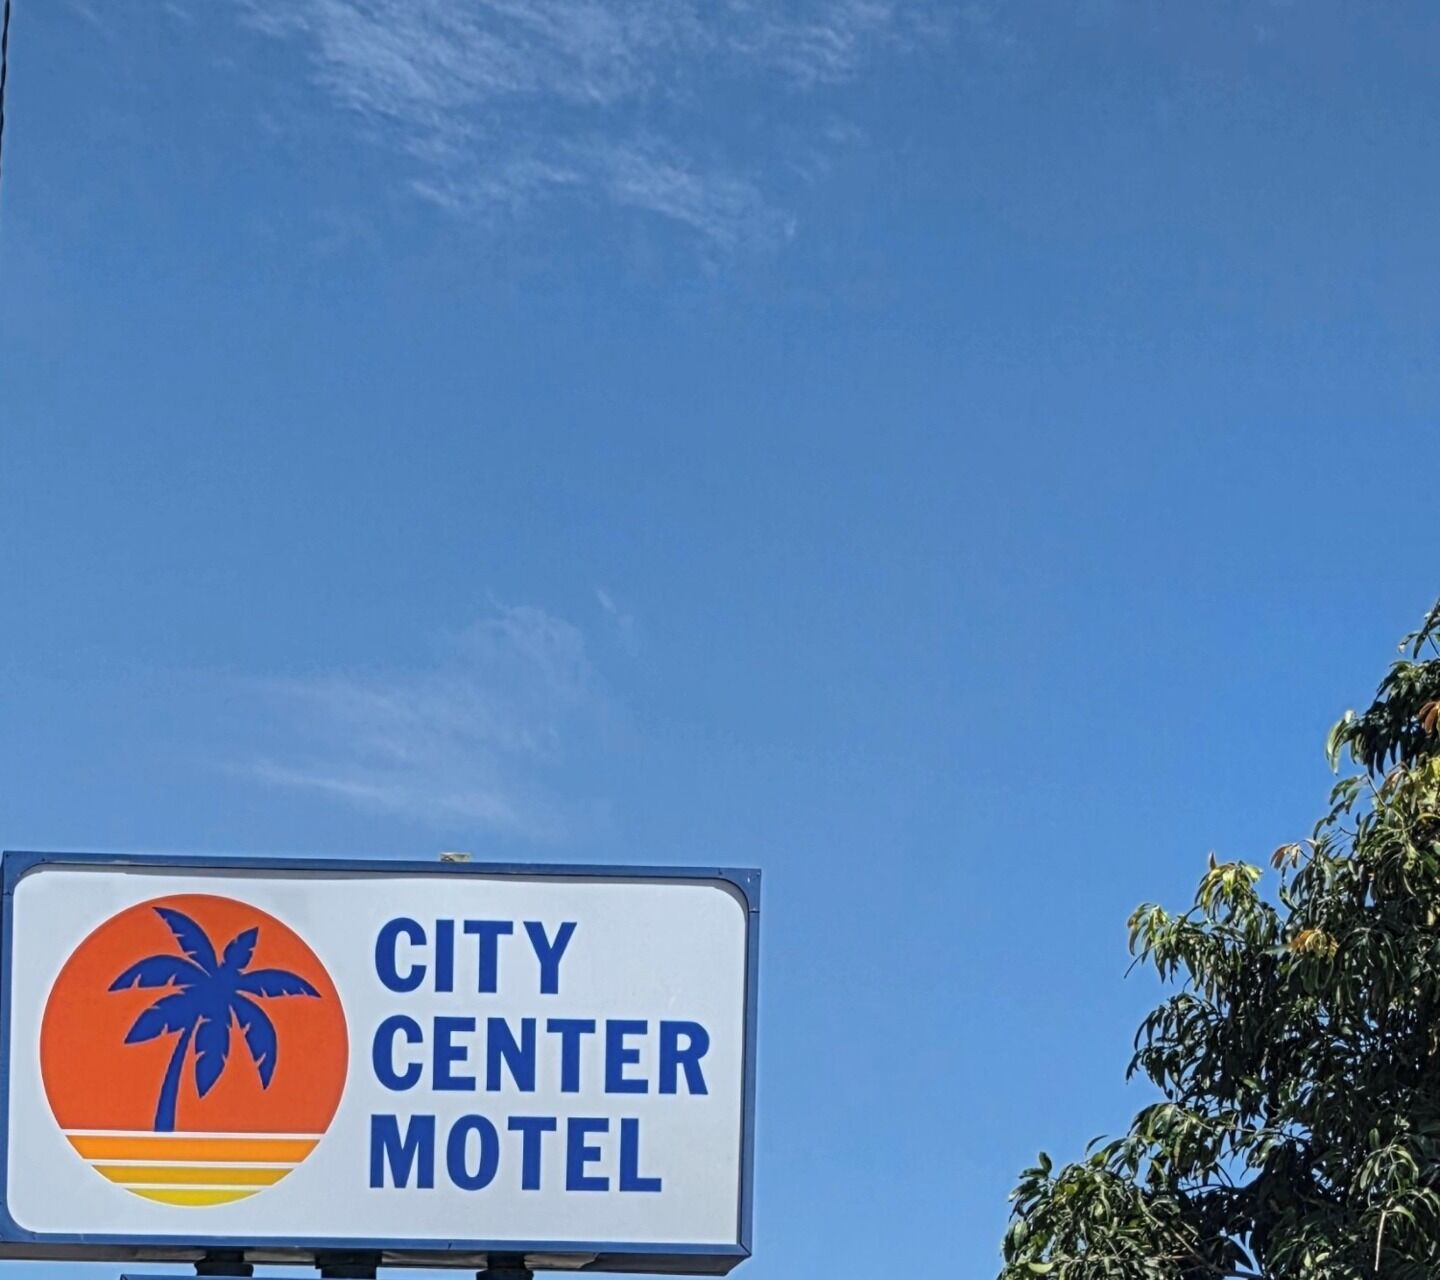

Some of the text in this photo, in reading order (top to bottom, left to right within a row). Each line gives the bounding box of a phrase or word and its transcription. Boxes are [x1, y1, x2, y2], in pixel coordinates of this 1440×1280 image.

[375, 918, 577, 994] CITY
[372, 1015, 709, 1095] CENTER
[370, 1114, 662, 1192] MOTEL
